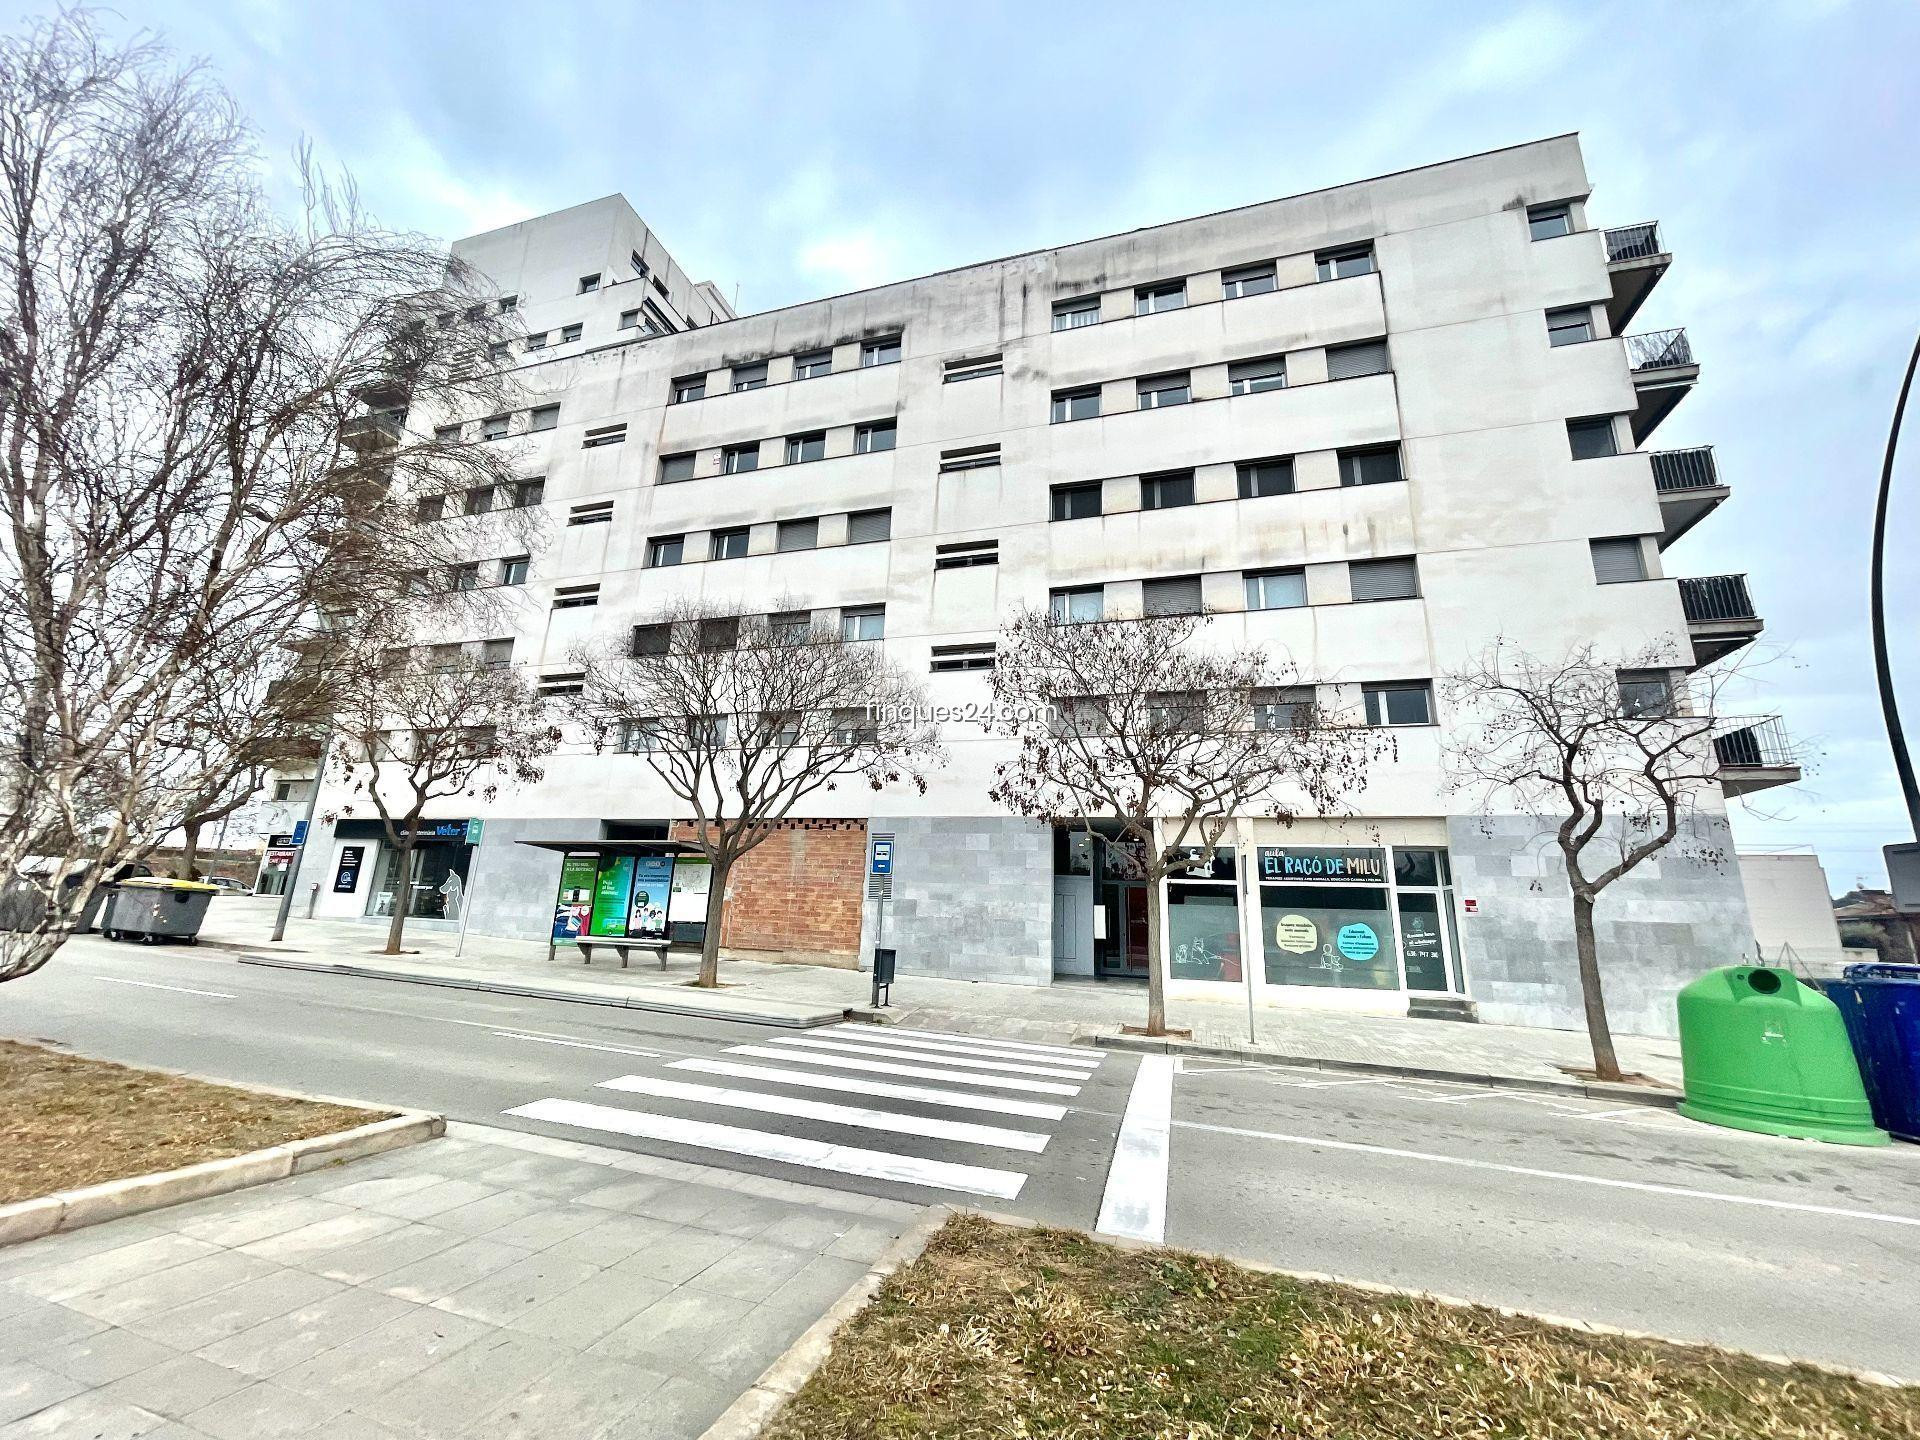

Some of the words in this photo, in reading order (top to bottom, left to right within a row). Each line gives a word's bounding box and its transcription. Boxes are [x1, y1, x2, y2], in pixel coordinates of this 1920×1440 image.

[1264, 848, 1285, 857] aula
[1264, 857, 1282, 875] EL
[1284, 855, 1323, 876] RACÓ
[1325, 858, 1345, 875] DE
[1346, 857, 1380, 876] MILU
